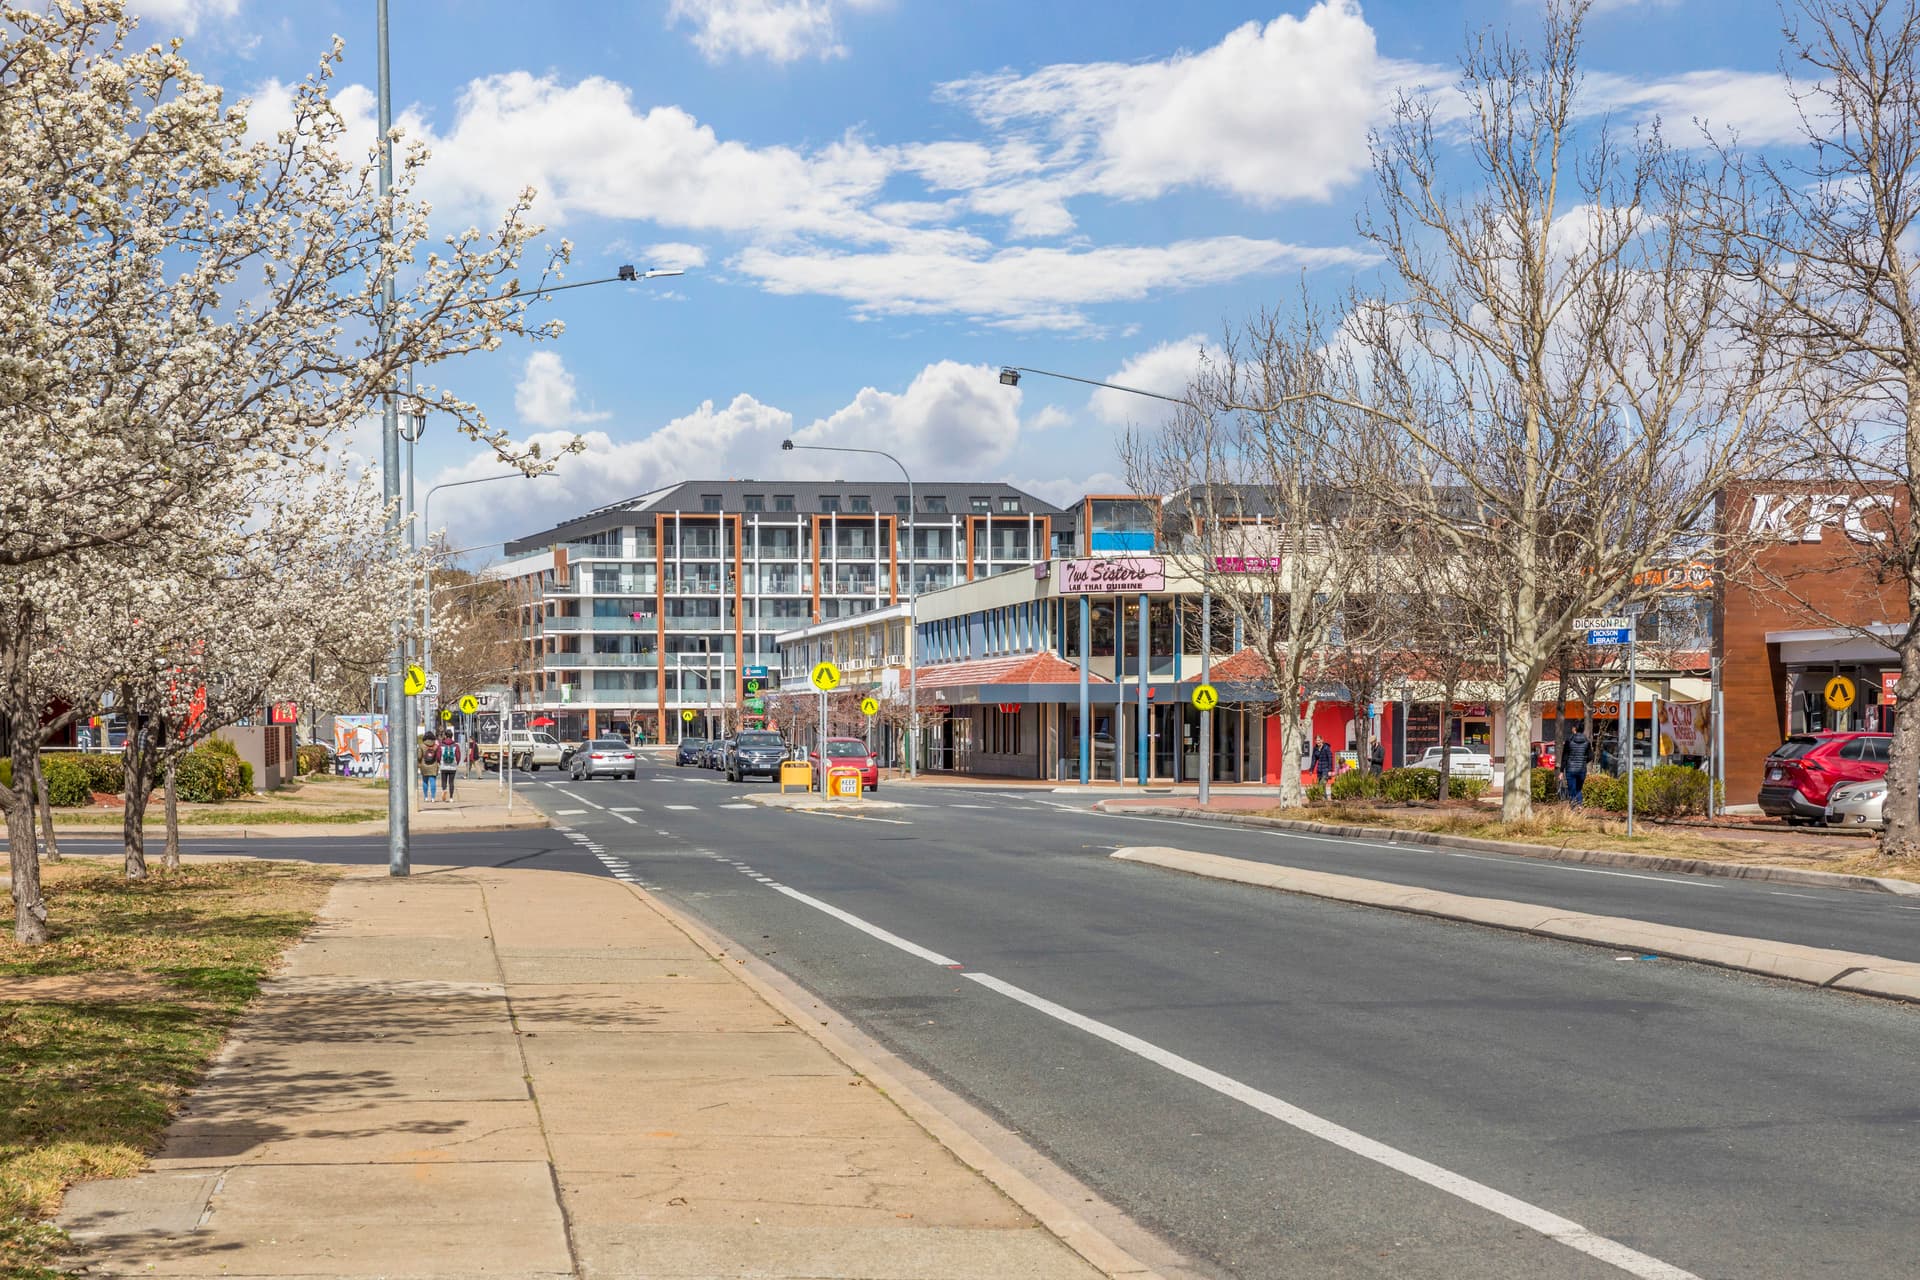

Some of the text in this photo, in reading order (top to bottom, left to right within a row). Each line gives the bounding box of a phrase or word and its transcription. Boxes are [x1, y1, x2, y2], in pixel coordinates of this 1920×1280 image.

[1749, 494, 1895, 544] KFC
[1067, 562, 1147, 583] Two Sisters
[1084, 583, 1102, 591] THAI
[1575, 618, 1625, 629] DICKSON PL
